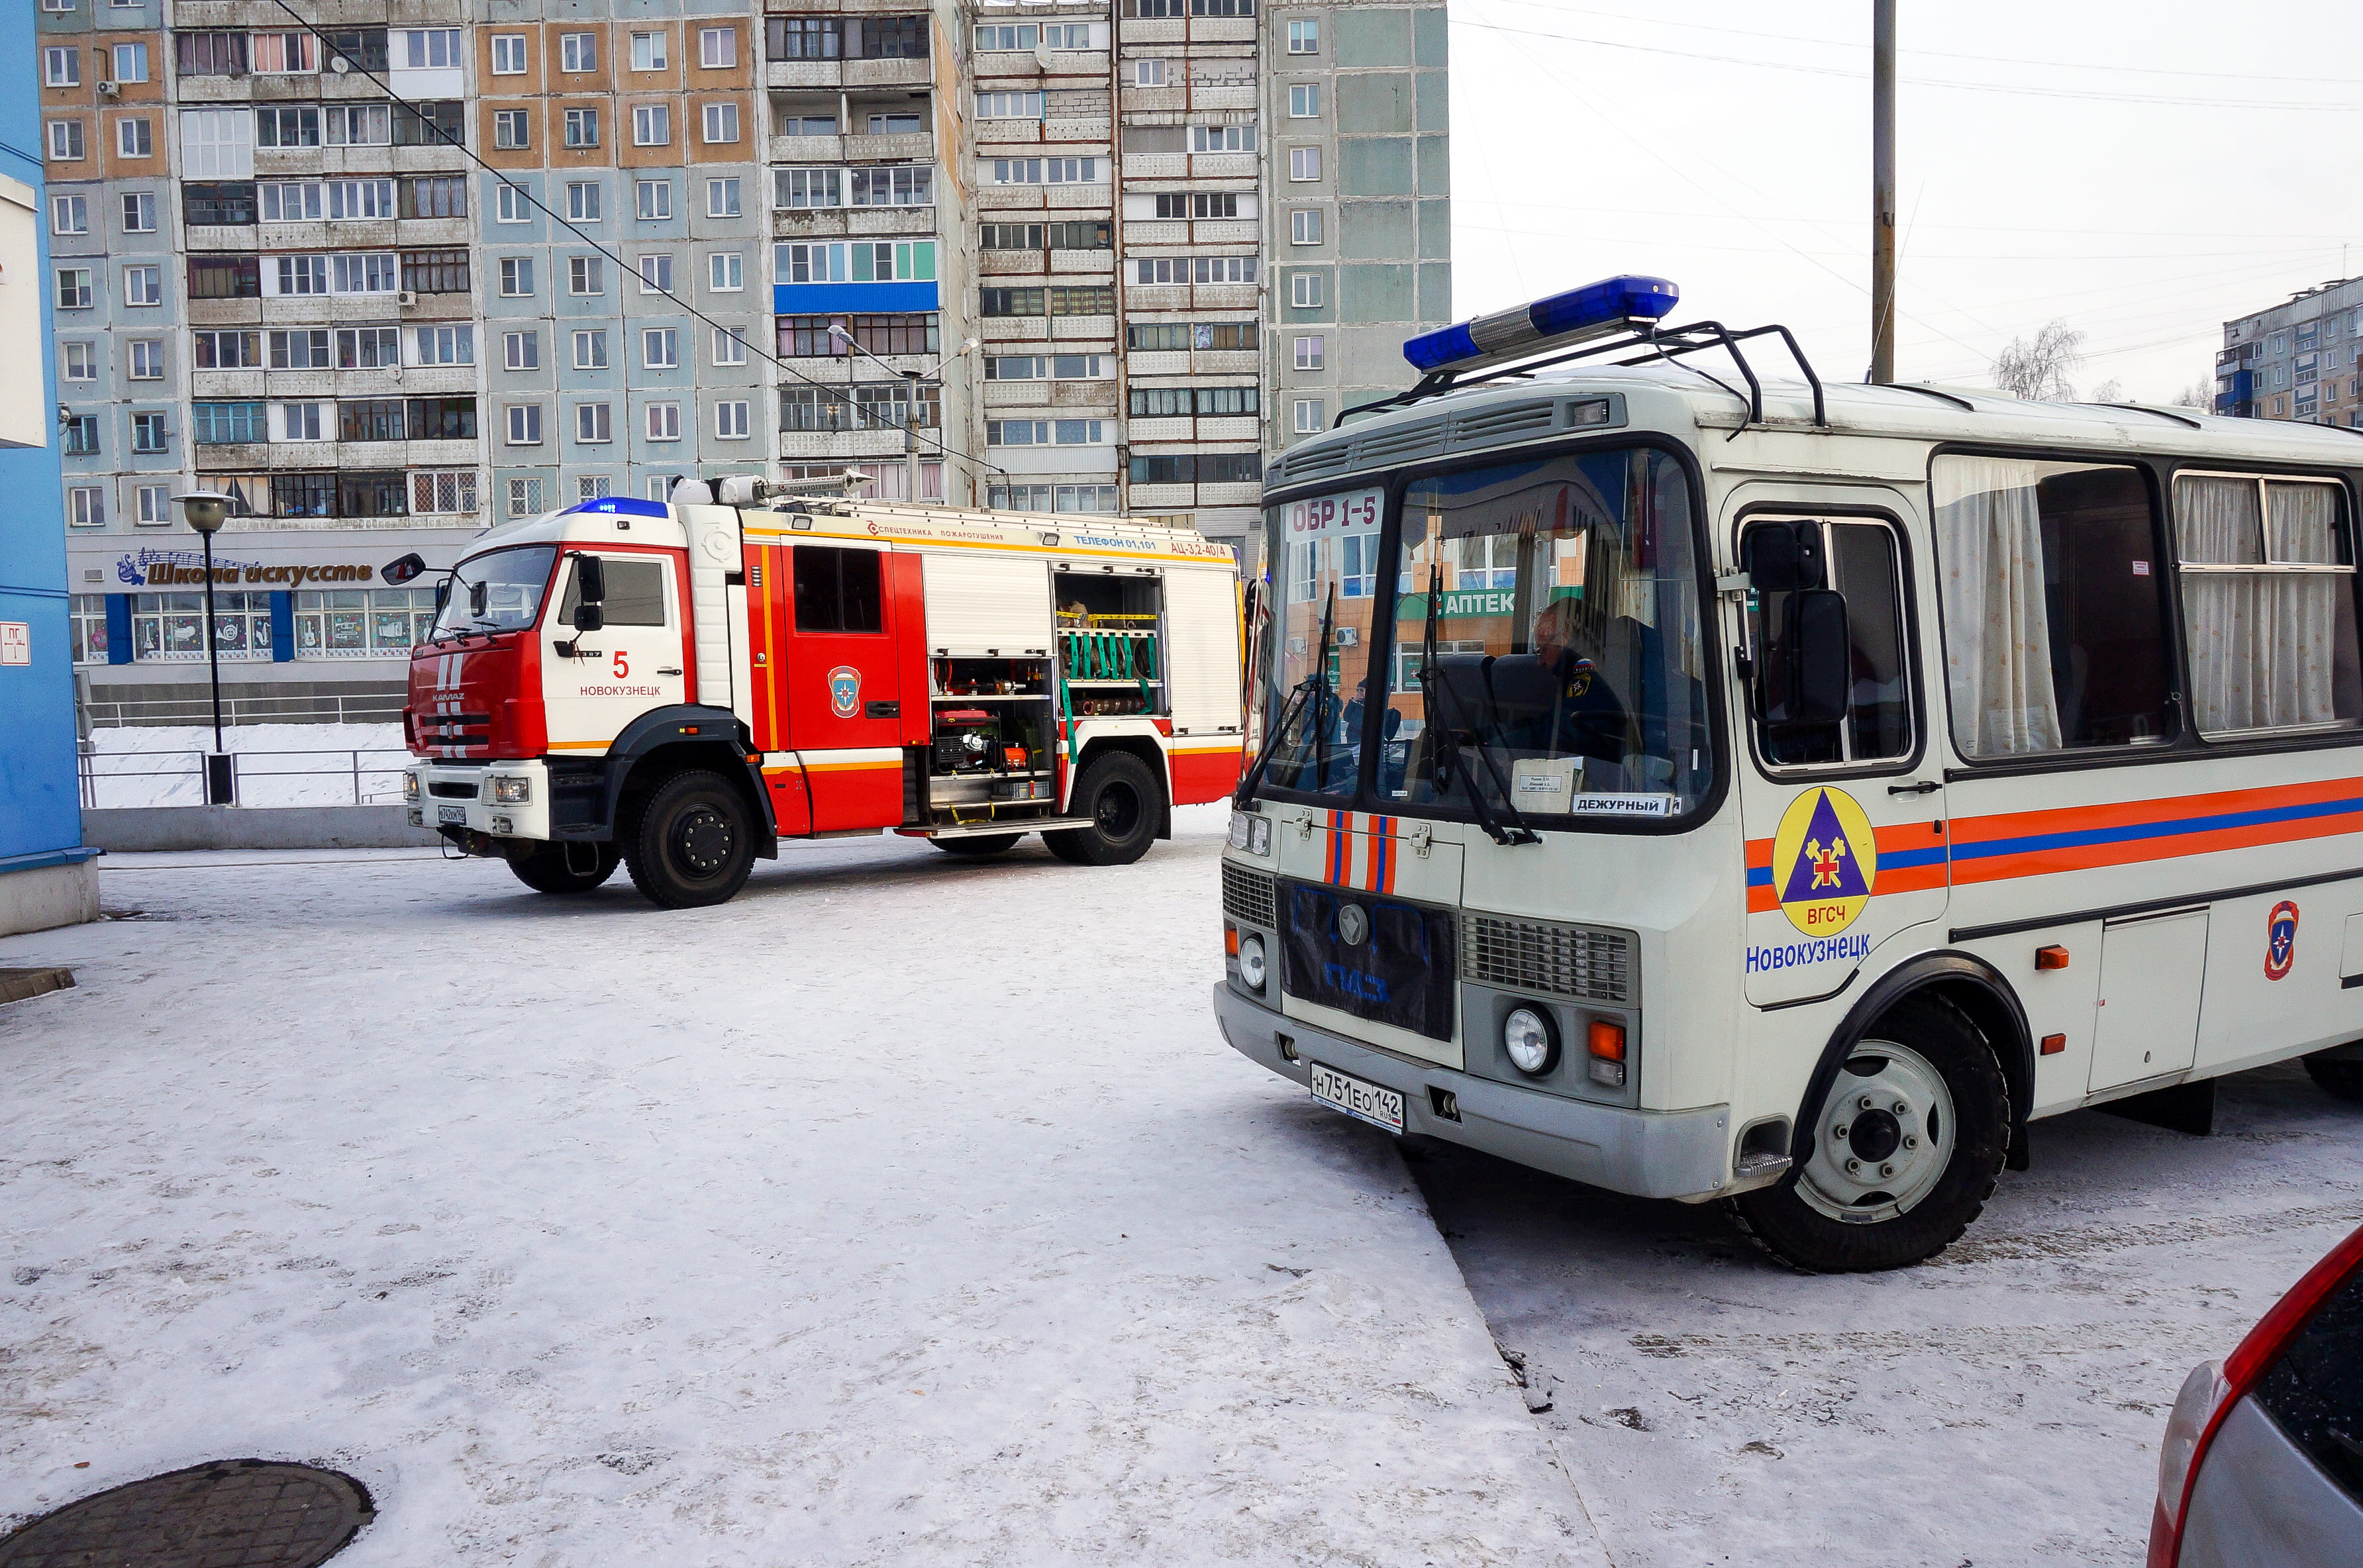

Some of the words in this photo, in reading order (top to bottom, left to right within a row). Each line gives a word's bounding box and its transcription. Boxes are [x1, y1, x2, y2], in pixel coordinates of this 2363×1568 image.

[1293, 499, 1335, 532] ОБР
[1341, 496, 1376, 527] 1-5
[878, 526, 932, 536] СПЕЦТЕХНИКА
[940, 530, 1004, 540] ПОЖАРОТУШЕНИЯ
[1074, 535, 1124, 548] ТЕЛЕФОН
[1125, 540, 1156, 551] 01,101
[1171, 542, 1226, 558] АЦ-3,2-40/4
[147, 562, 239, 585] Школа
[244, 564, 374, 588] искусств
[9, 628, 20, 639] ПГ
[613, 650, 629, 679] 5
[432, 693, 465, 702] KAMAZ
[580, 686, 661, 697] НОВОКУЗНЕЦК
[1577, 799, 1659, 812] ДЕЖУРНЫЙ
[1807, 905, 1846, 924] ВГСЧ
[1746, 934, 1870, 973] Новокузнецк
[1380, 1110, 1392, 1120] RUS
